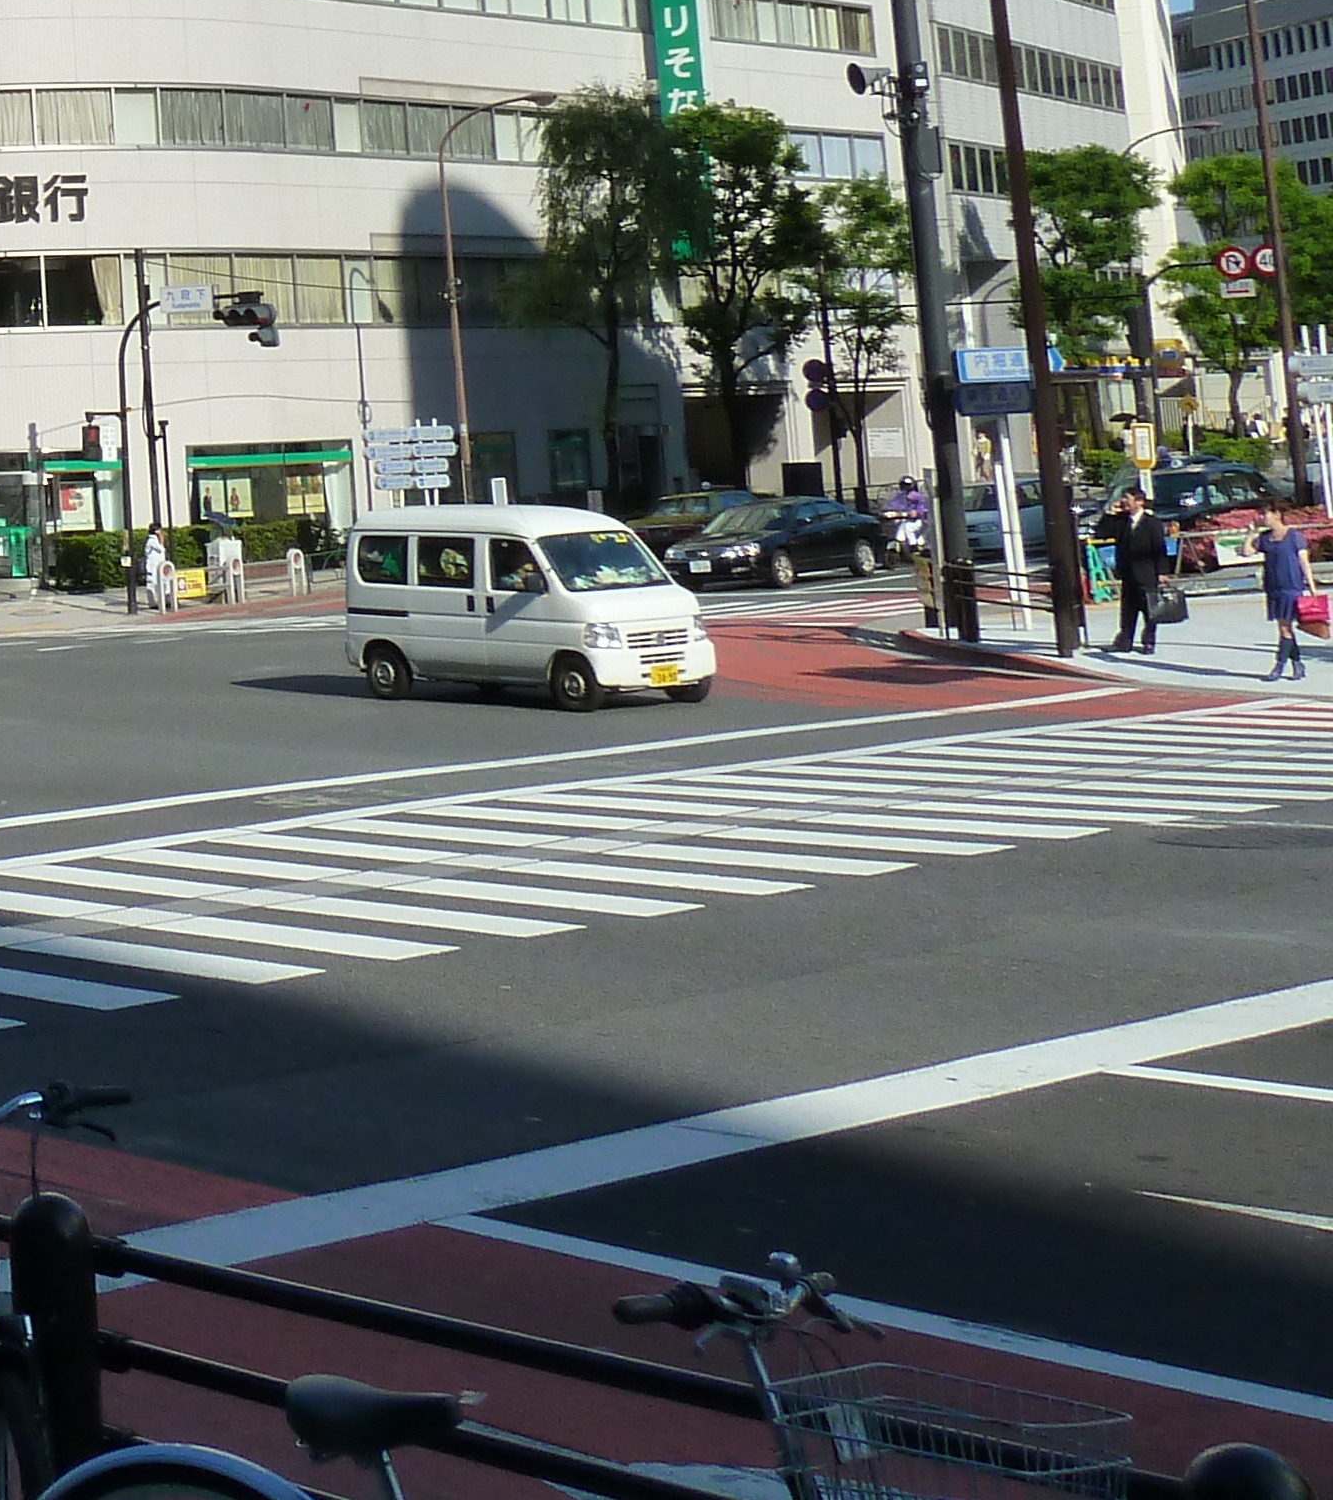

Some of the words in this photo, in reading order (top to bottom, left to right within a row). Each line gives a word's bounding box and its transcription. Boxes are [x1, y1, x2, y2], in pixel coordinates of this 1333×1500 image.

[166, 289, 205, 301] 九段下
[975, 353, 1024, 367] 内堀通
